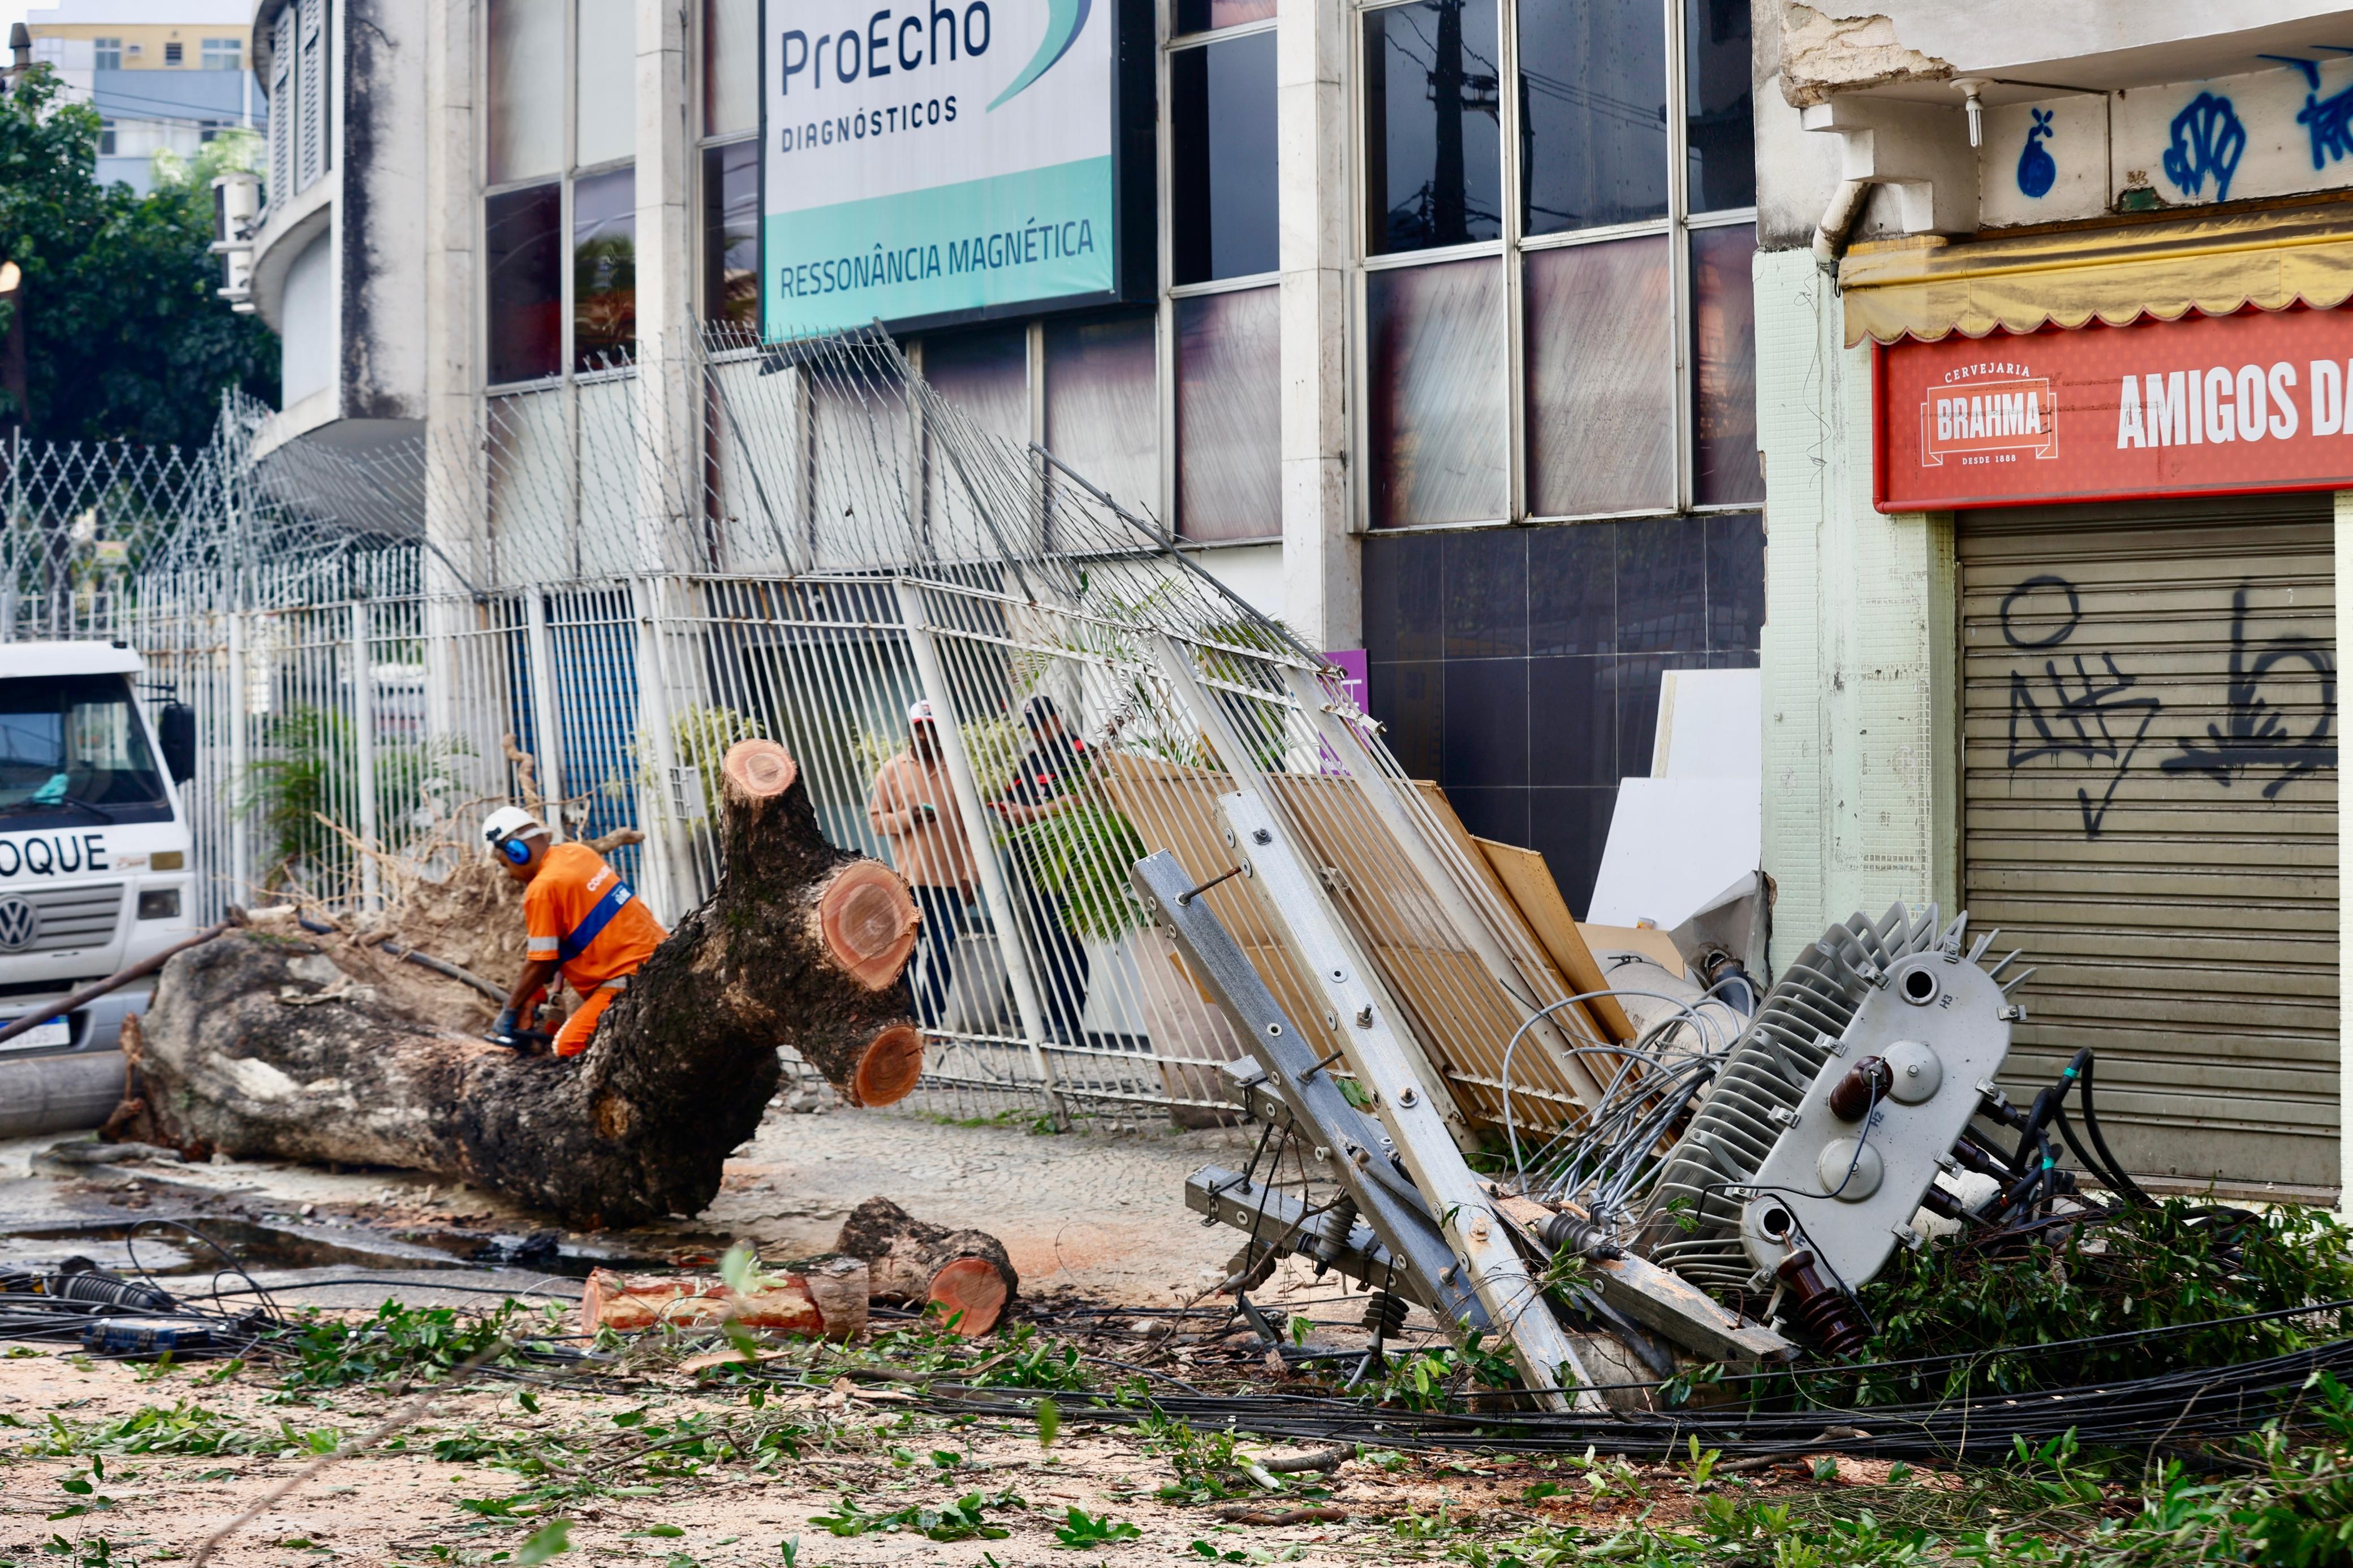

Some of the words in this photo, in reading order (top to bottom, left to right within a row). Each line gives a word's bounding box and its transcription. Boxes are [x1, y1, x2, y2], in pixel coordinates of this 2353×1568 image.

[782, 0, 990, 96] ProEcho
[782, 96, 957, 153] DIAGNÓSTICOS
[781, 243, 942, 299] RESSONÂNCIA
[949, 217, 1094, 275] MAGNÉTICA
[1945, 362, 2030, 383] CERVEJARIA
[1937, 391, 2042, 440] BRAHMA
[2117, 361, 2299, 450] AMIGOS
[1995, 454, 2017, 463] 1888
[1939, 995, 1953, 1009] H3
[1870, 1112, 1884, 1127] H2
